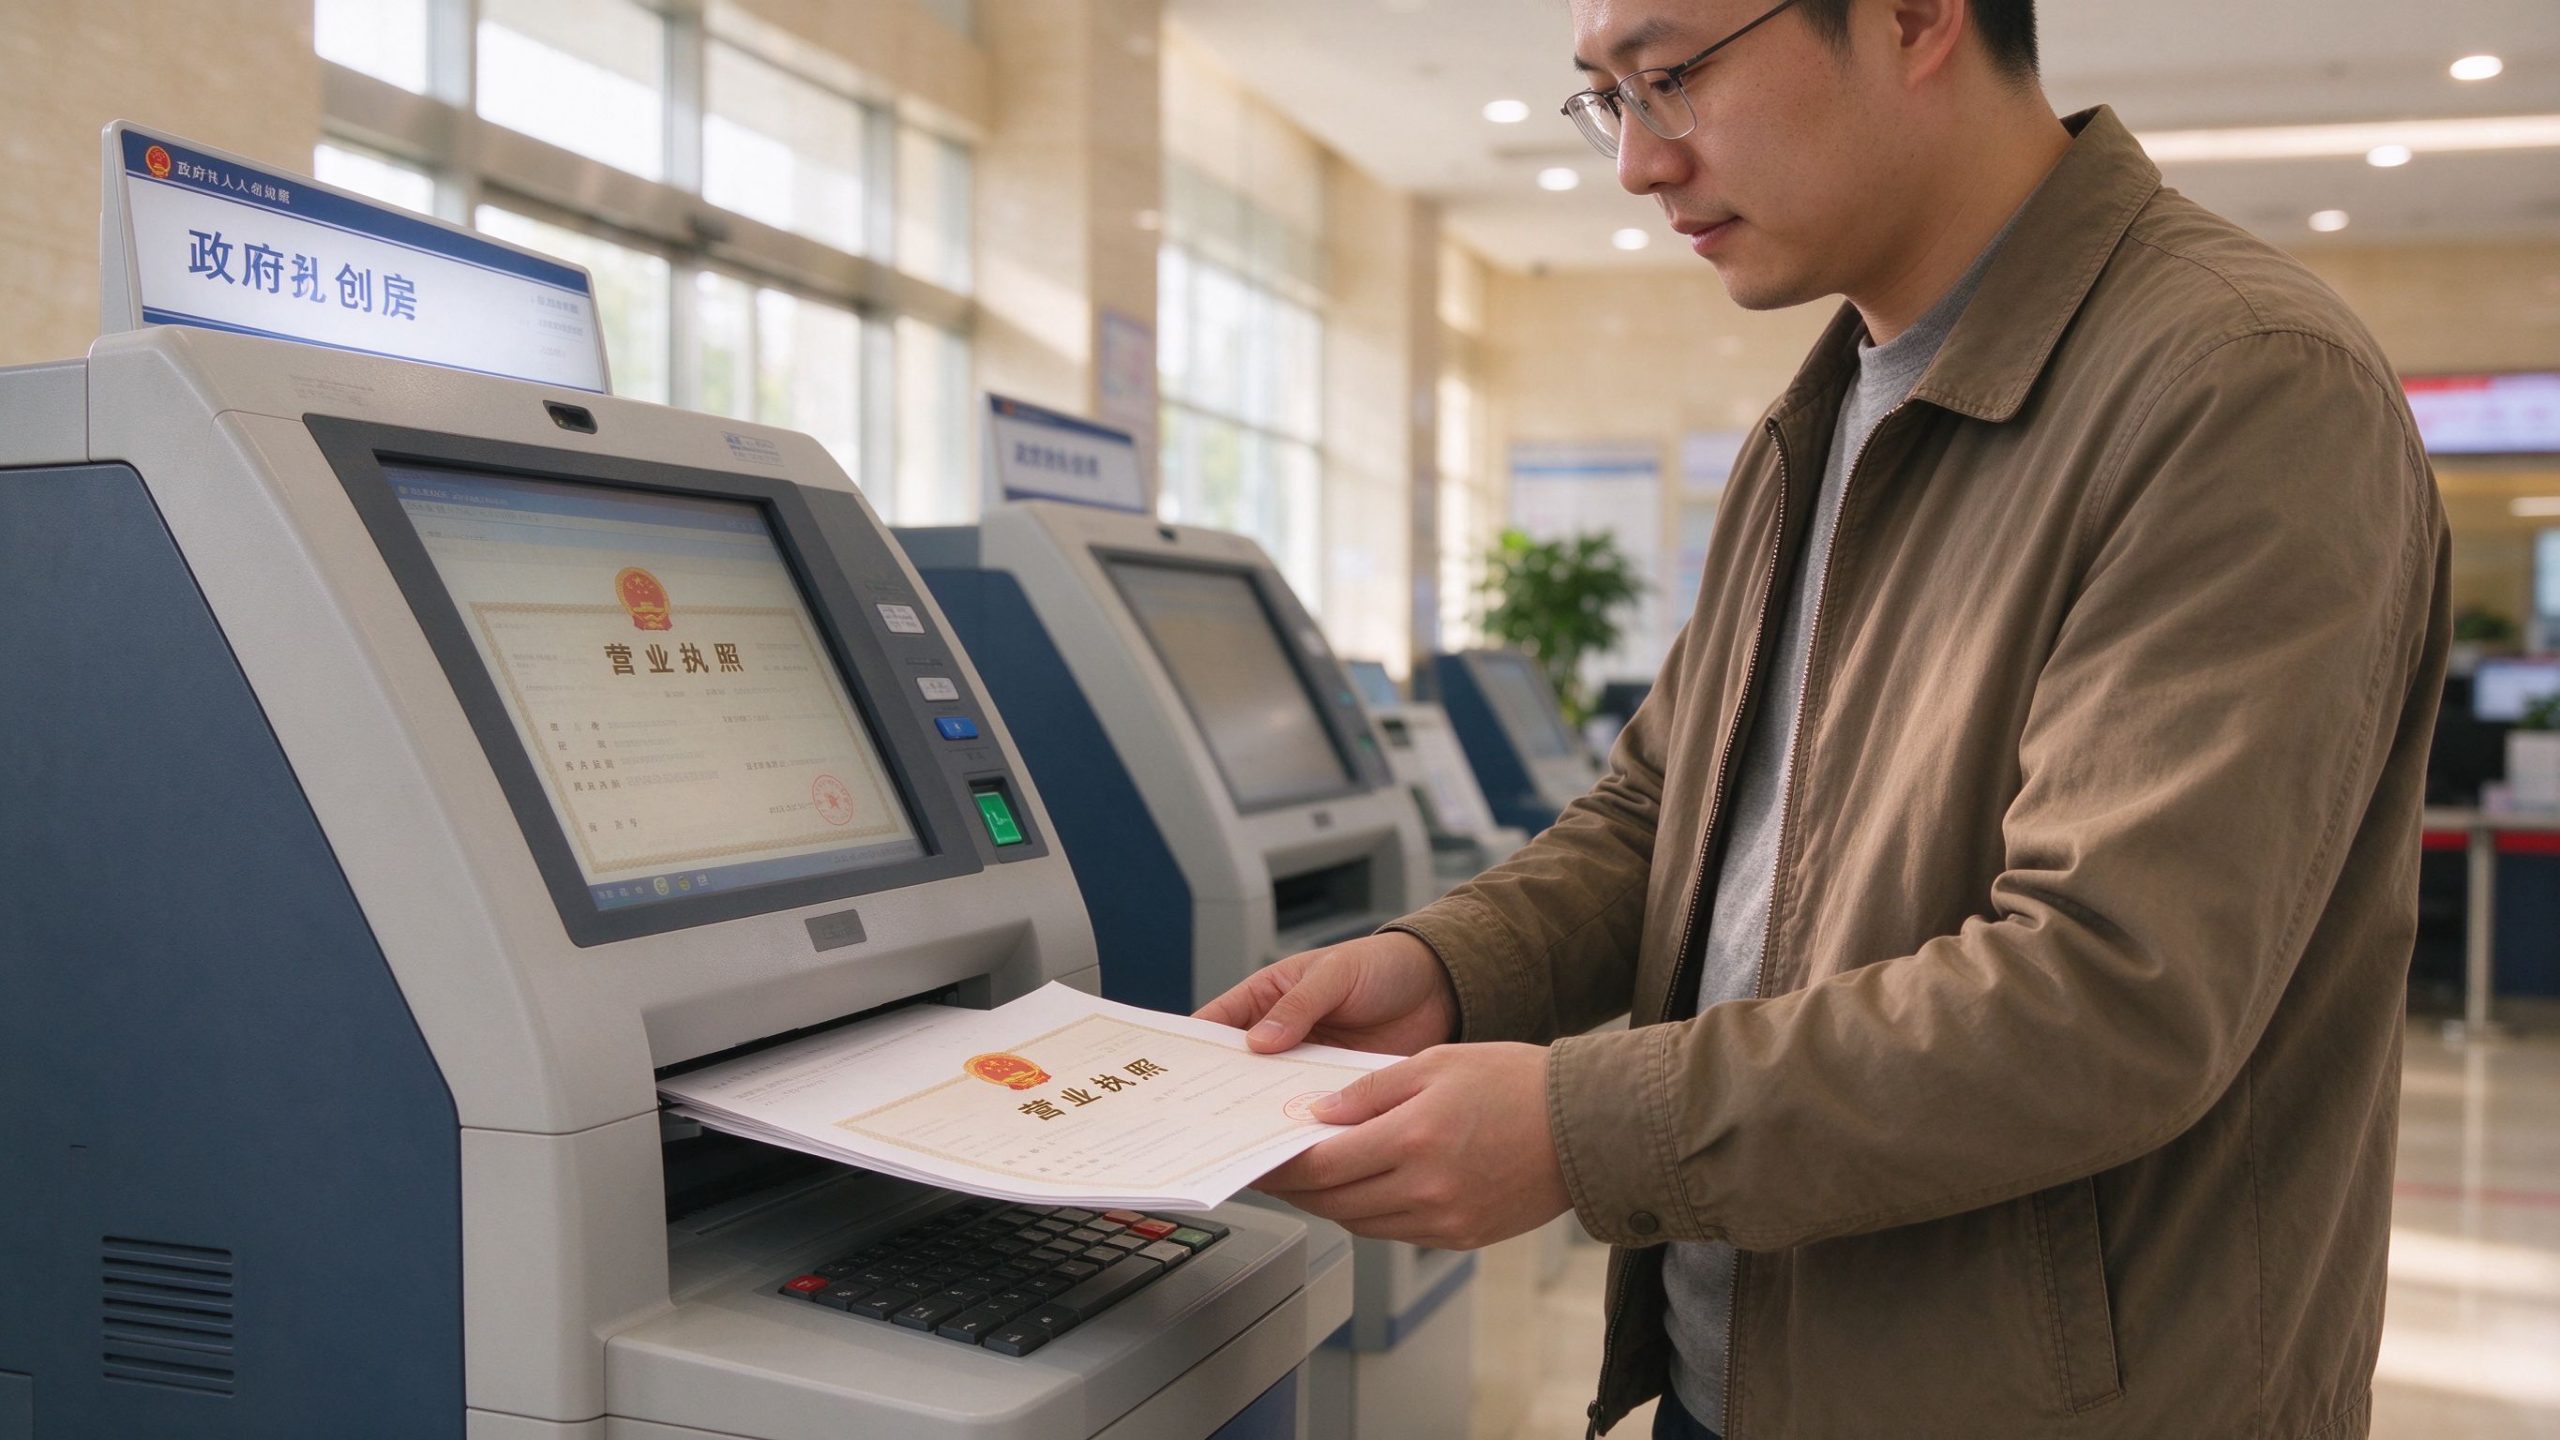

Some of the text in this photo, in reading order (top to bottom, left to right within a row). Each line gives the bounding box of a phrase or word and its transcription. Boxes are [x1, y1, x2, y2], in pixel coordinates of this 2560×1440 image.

[603, 642, 745, 676] 营业执照
[1017, 1057, 1169, 1121] 营业执照
